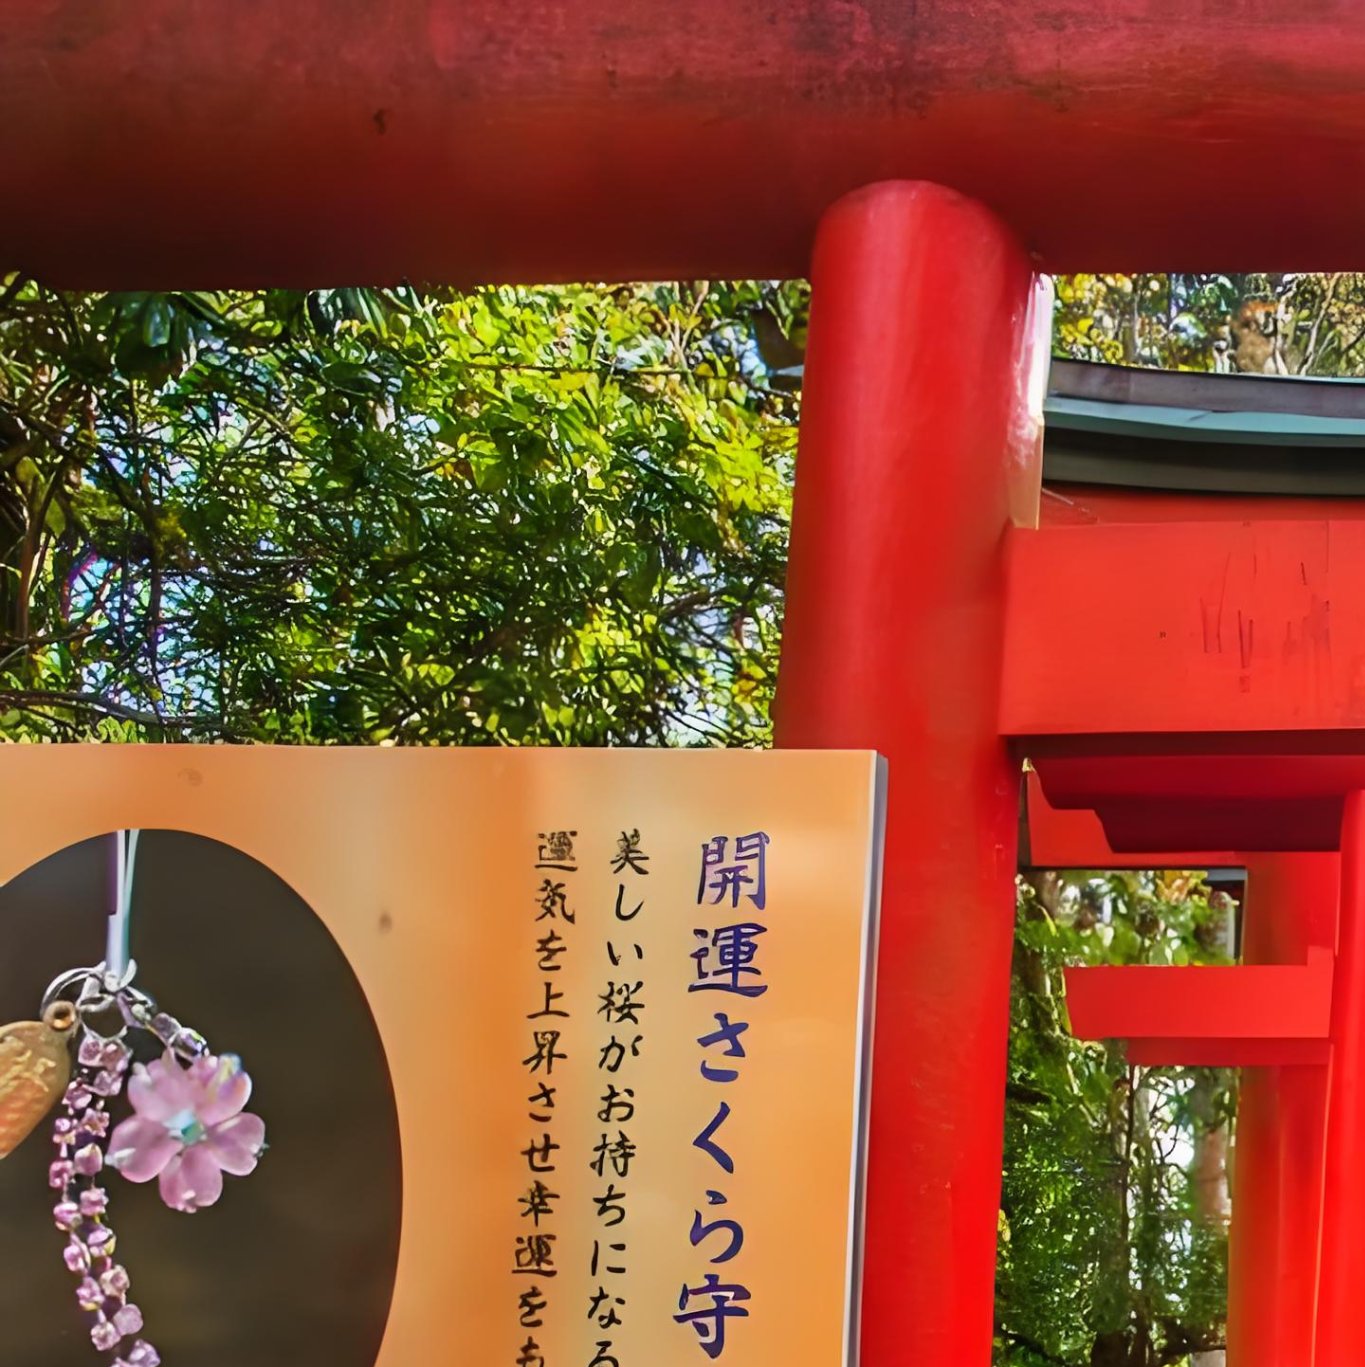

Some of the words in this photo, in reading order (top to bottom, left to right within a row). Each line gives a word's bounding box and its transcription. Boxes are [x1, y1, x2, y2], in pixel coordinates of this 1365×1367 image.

[672, 831, 770, 1360] 開運さくら守
